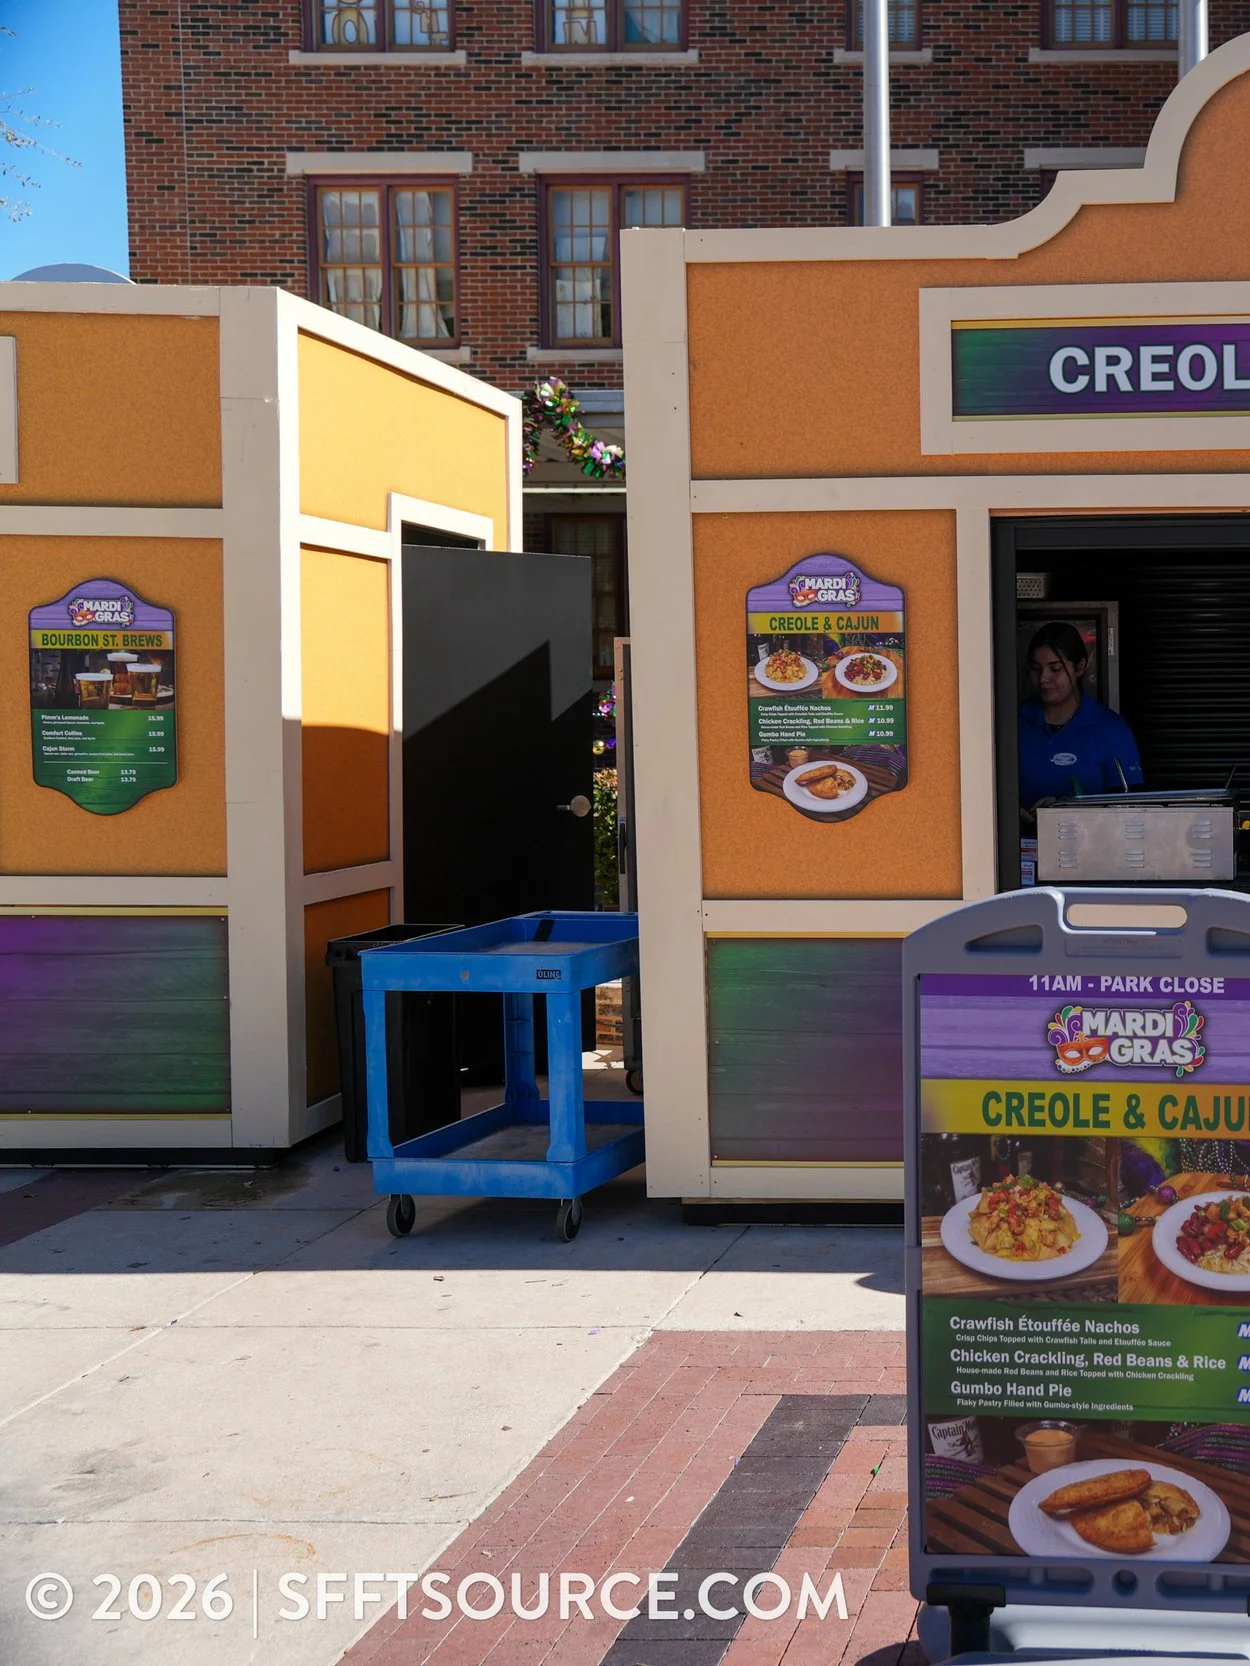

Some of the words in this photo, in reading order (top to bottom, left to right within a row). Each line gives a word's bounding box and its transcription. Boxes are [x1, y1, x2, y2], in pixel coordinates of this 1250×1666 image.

[805, 577, 846, 589] MARDI
[817, 589, 854, 601] GRAS
[84, 600, 121, 611] MARDI
[95, 611, 128, 623] GRAS
[769, 616, 819, 631] CREOLE
[823, 616, 832, 631] &
[836, 616, 879, 630] CAJUN
[42, 634, 99, 647] BOURBON
[102, 635, 118, 647] ST.
[123, 634, 162, 647] BREWS
[1029, 974, 1082, 991] 11AM
[1100, 975, 1153, 993] PARK
[1159, 976, 1225, 994] CLOSE
[1082, 1010, 1174, 1038] MARDI
[1109, 1038, 1194, 1065] GRAS
[982, 1091, 1111, 1129] CREOLE
[1122, 1093, 1146, 1129] &
[950, 1316, 1013, 1331] Crawfish
[1018, 1314, 1080, 1332] Étouffée
[1085, 1319, 1139, 1334] Nachos
[956, 1334, 975, 1343] Crisp
[977, 1335, 997, 1343] Chips
[999, 1335, 1026, 1344] Topped
[1028, 1336, 1044, 1344] with
[1046, 1336, 1078, 1344] Crawfish
[1080, 1337, 1096, 1345] Tails
[1099, 1337, 1112, 1345] and
[1148, 1339, 1171, 1347] Sauce
[950, 1349, 1010, 1363] Chicken
[1014, 1350, 1088, 1368] Crackling,
[1093, 1353, 1121, 1366] Red
[1126, 1353, 1172, 1368] Beans
[1177, 1354, 1189, 1368] &
[1193, 1355, 1226, 1369] Rice
[956, 1366, 1002, 1375] House-made
[1003, 1367, 1018, 1375] Red
[1020, 1368, 1043, 1376] Beans
[1045, 1368, 1059, 1377] and
[1061, 1369, 1077, 1377] Rice
[1080, 1370, 1106, 1379] Topped
[1108, 1370, 1124, 1378] with
[1126, 1370, 1156, 1379] Chicken
[1158, 1371, 1194, 1381] Crackling
[951, 1381, 1002, 1395] Gumbo
[1006, 1382, 1044, 1396] Hand
[1049, 1384, 1072, 1397] Pie
[957, 1398, 977, 1407] Flaky
[978, 1399, 1001, 1408] Pastry
[1003, 1400, 1023, 1408] Filled
[1025, 1400, 1041, 1408] with
[1043, 1401, 1089, 1410] Gumbo-style
[1091, 1402, 1133, 1411] Ingredients
[931, 1423, 964, 1440] Captain
